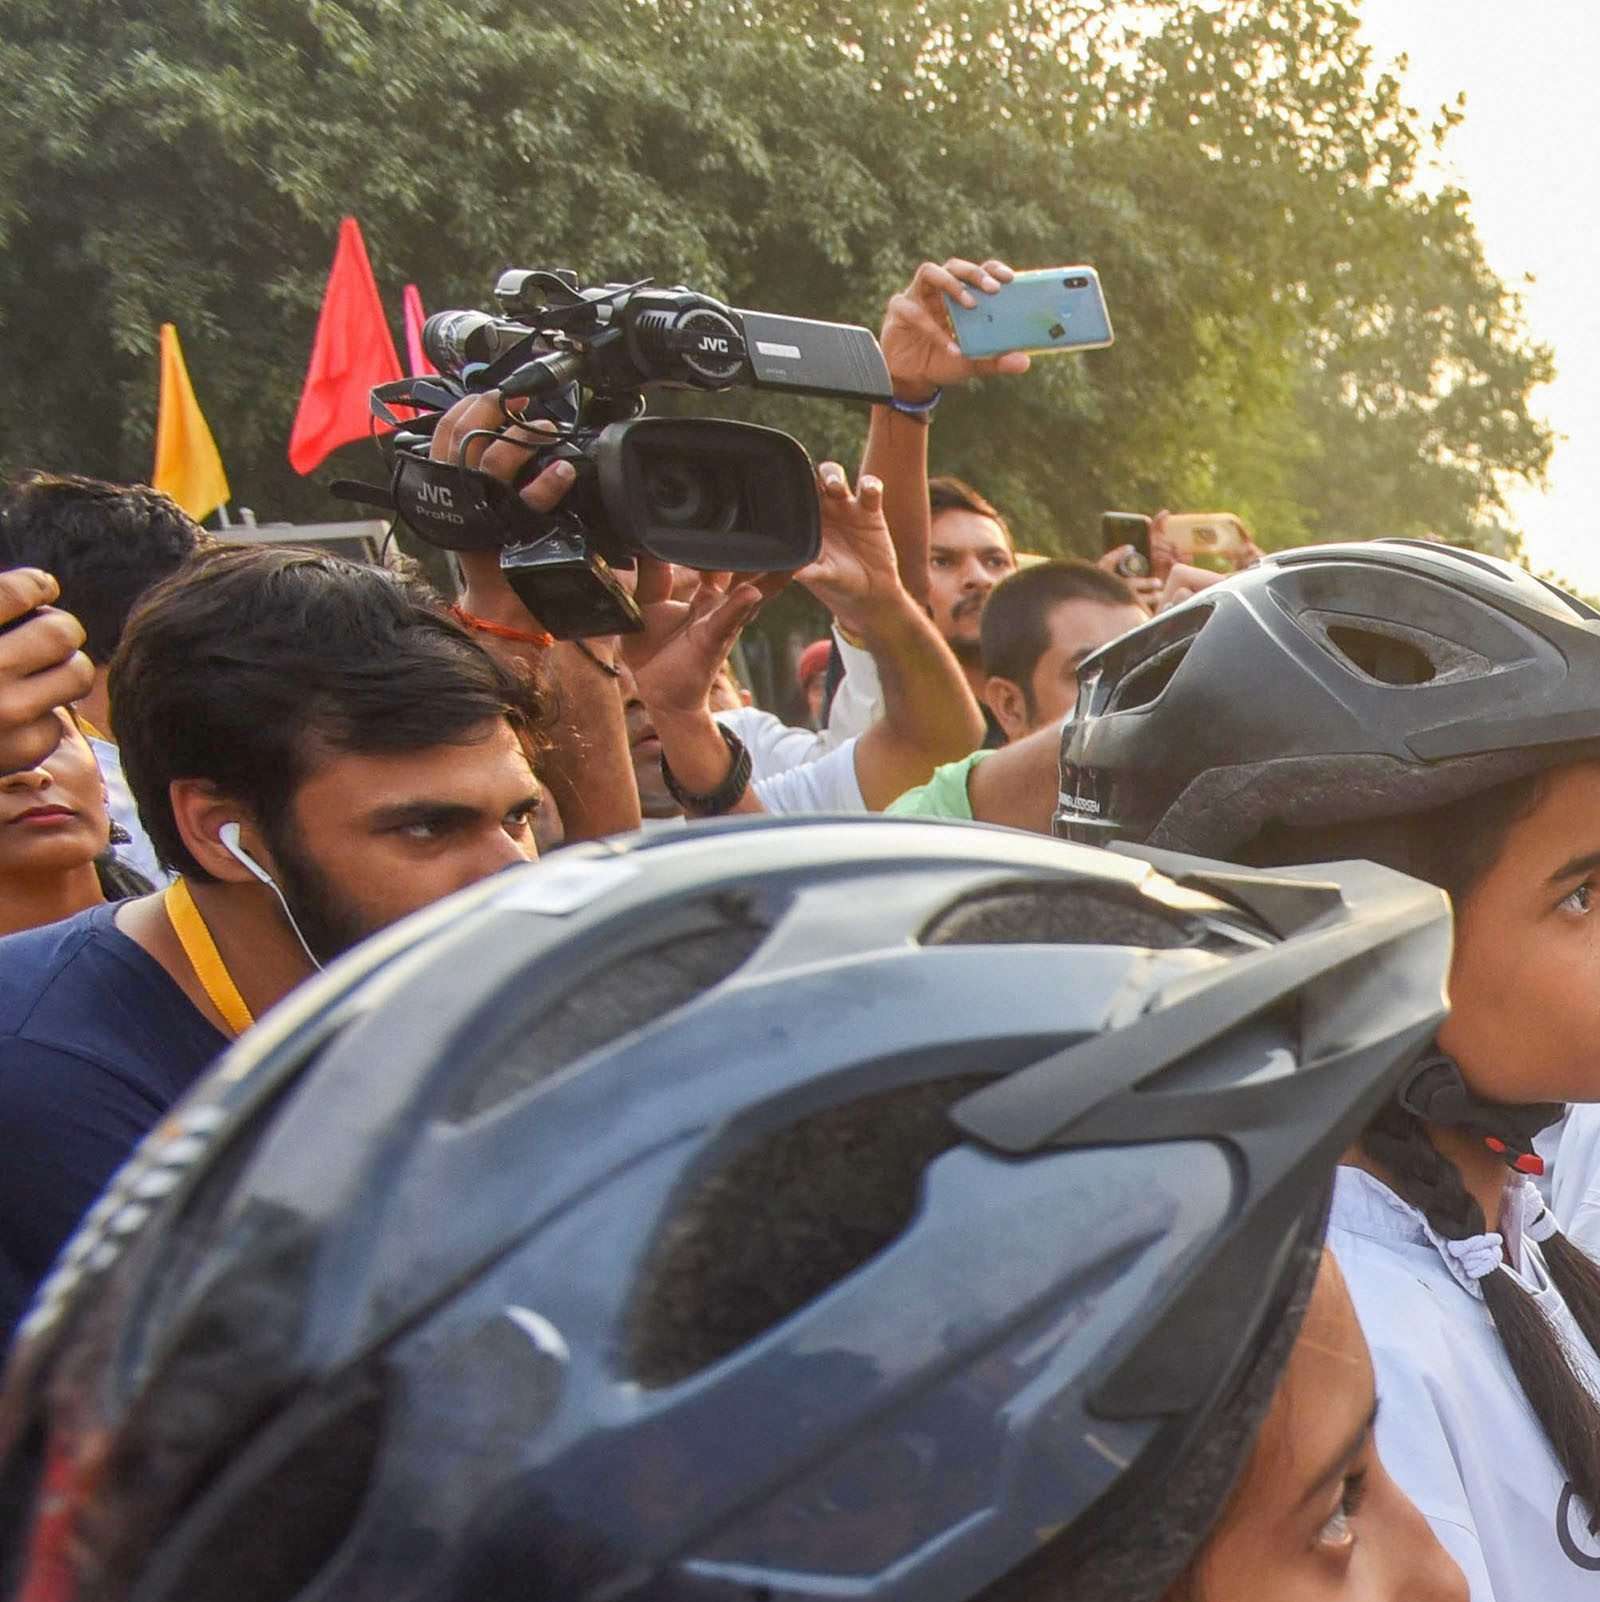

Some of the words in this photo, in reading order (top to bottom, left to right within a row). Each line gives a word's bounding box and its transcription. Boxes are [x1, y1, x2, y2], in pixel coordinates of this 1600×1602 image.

[699, 335, 729, 353] JVC
[417, 482, 453, 507] JVC
[415, 505, 464, 525] ProHD
